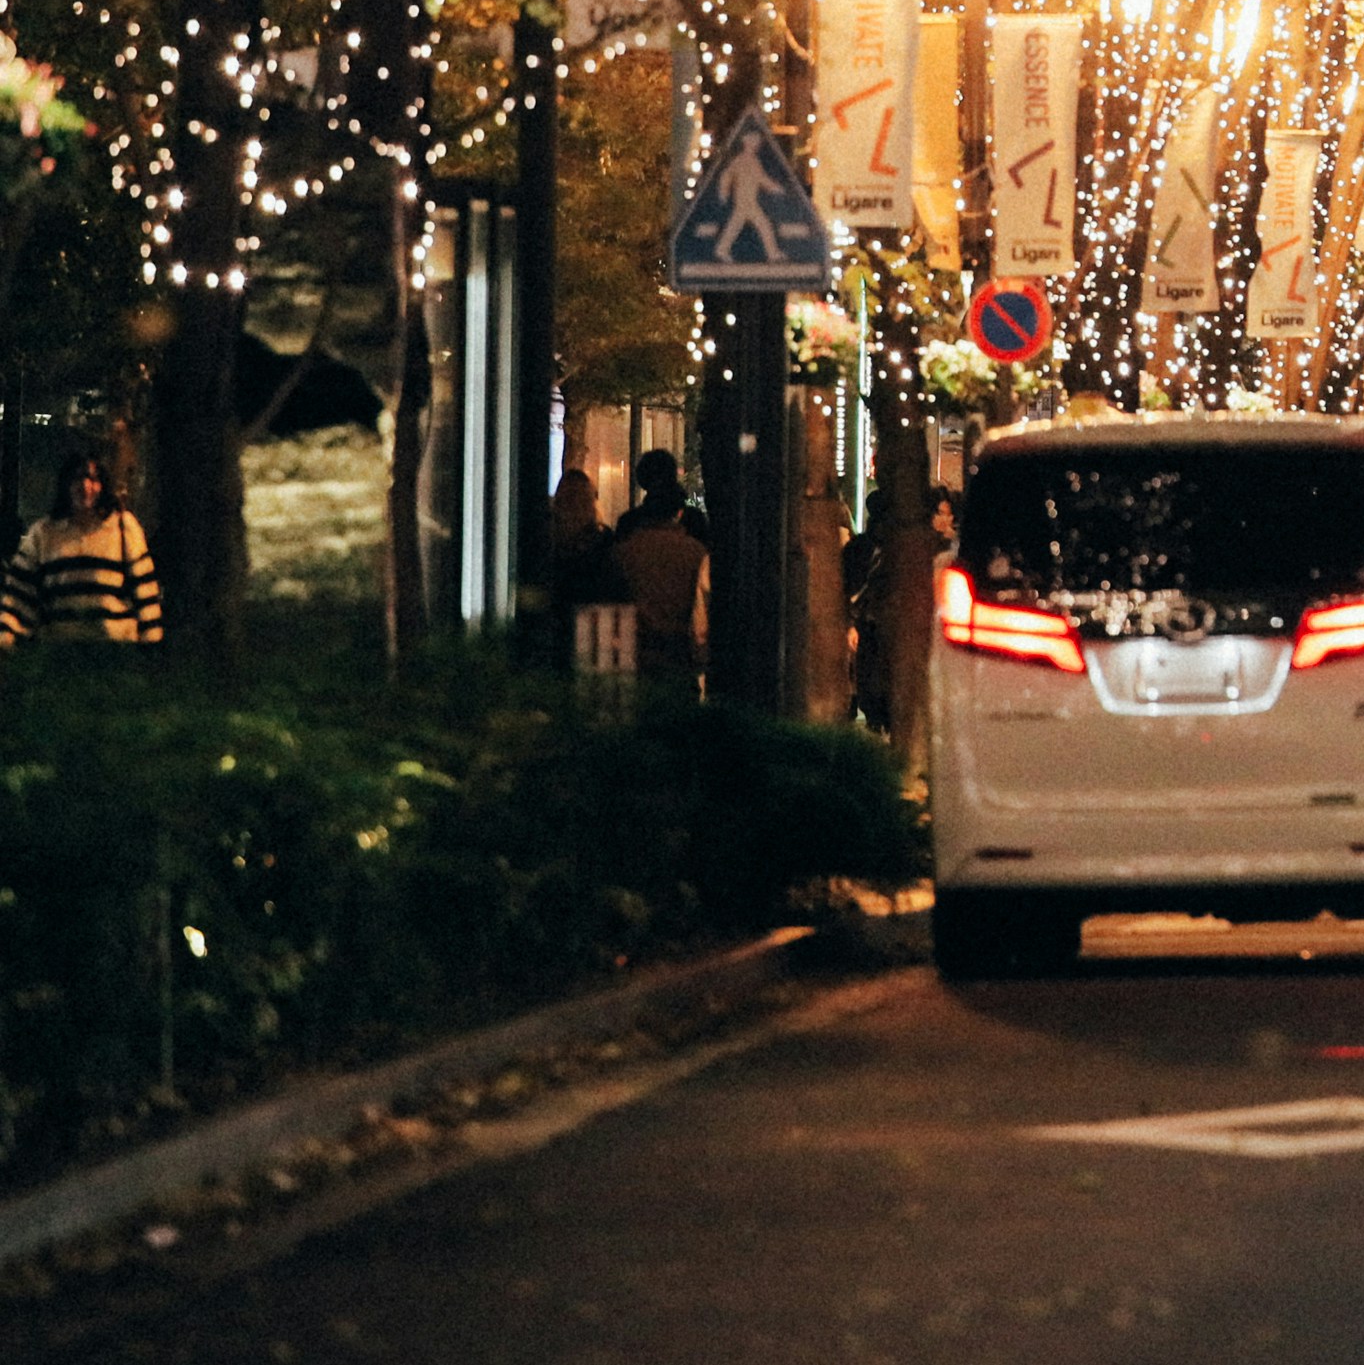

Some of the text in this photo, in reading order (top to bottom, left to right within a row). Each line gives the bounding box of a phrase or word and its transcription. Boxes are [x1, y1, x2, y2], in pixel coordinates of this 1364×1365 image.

[1024, 29, 1050, 128] ESSENCE
[1274, 146, 1297, 228] MOTIVATE
[831, 192, 893, 210] Ligare
[1156, 284, 1205, 301] Ligare
[1261, 314, 1304, 327] Ligare
